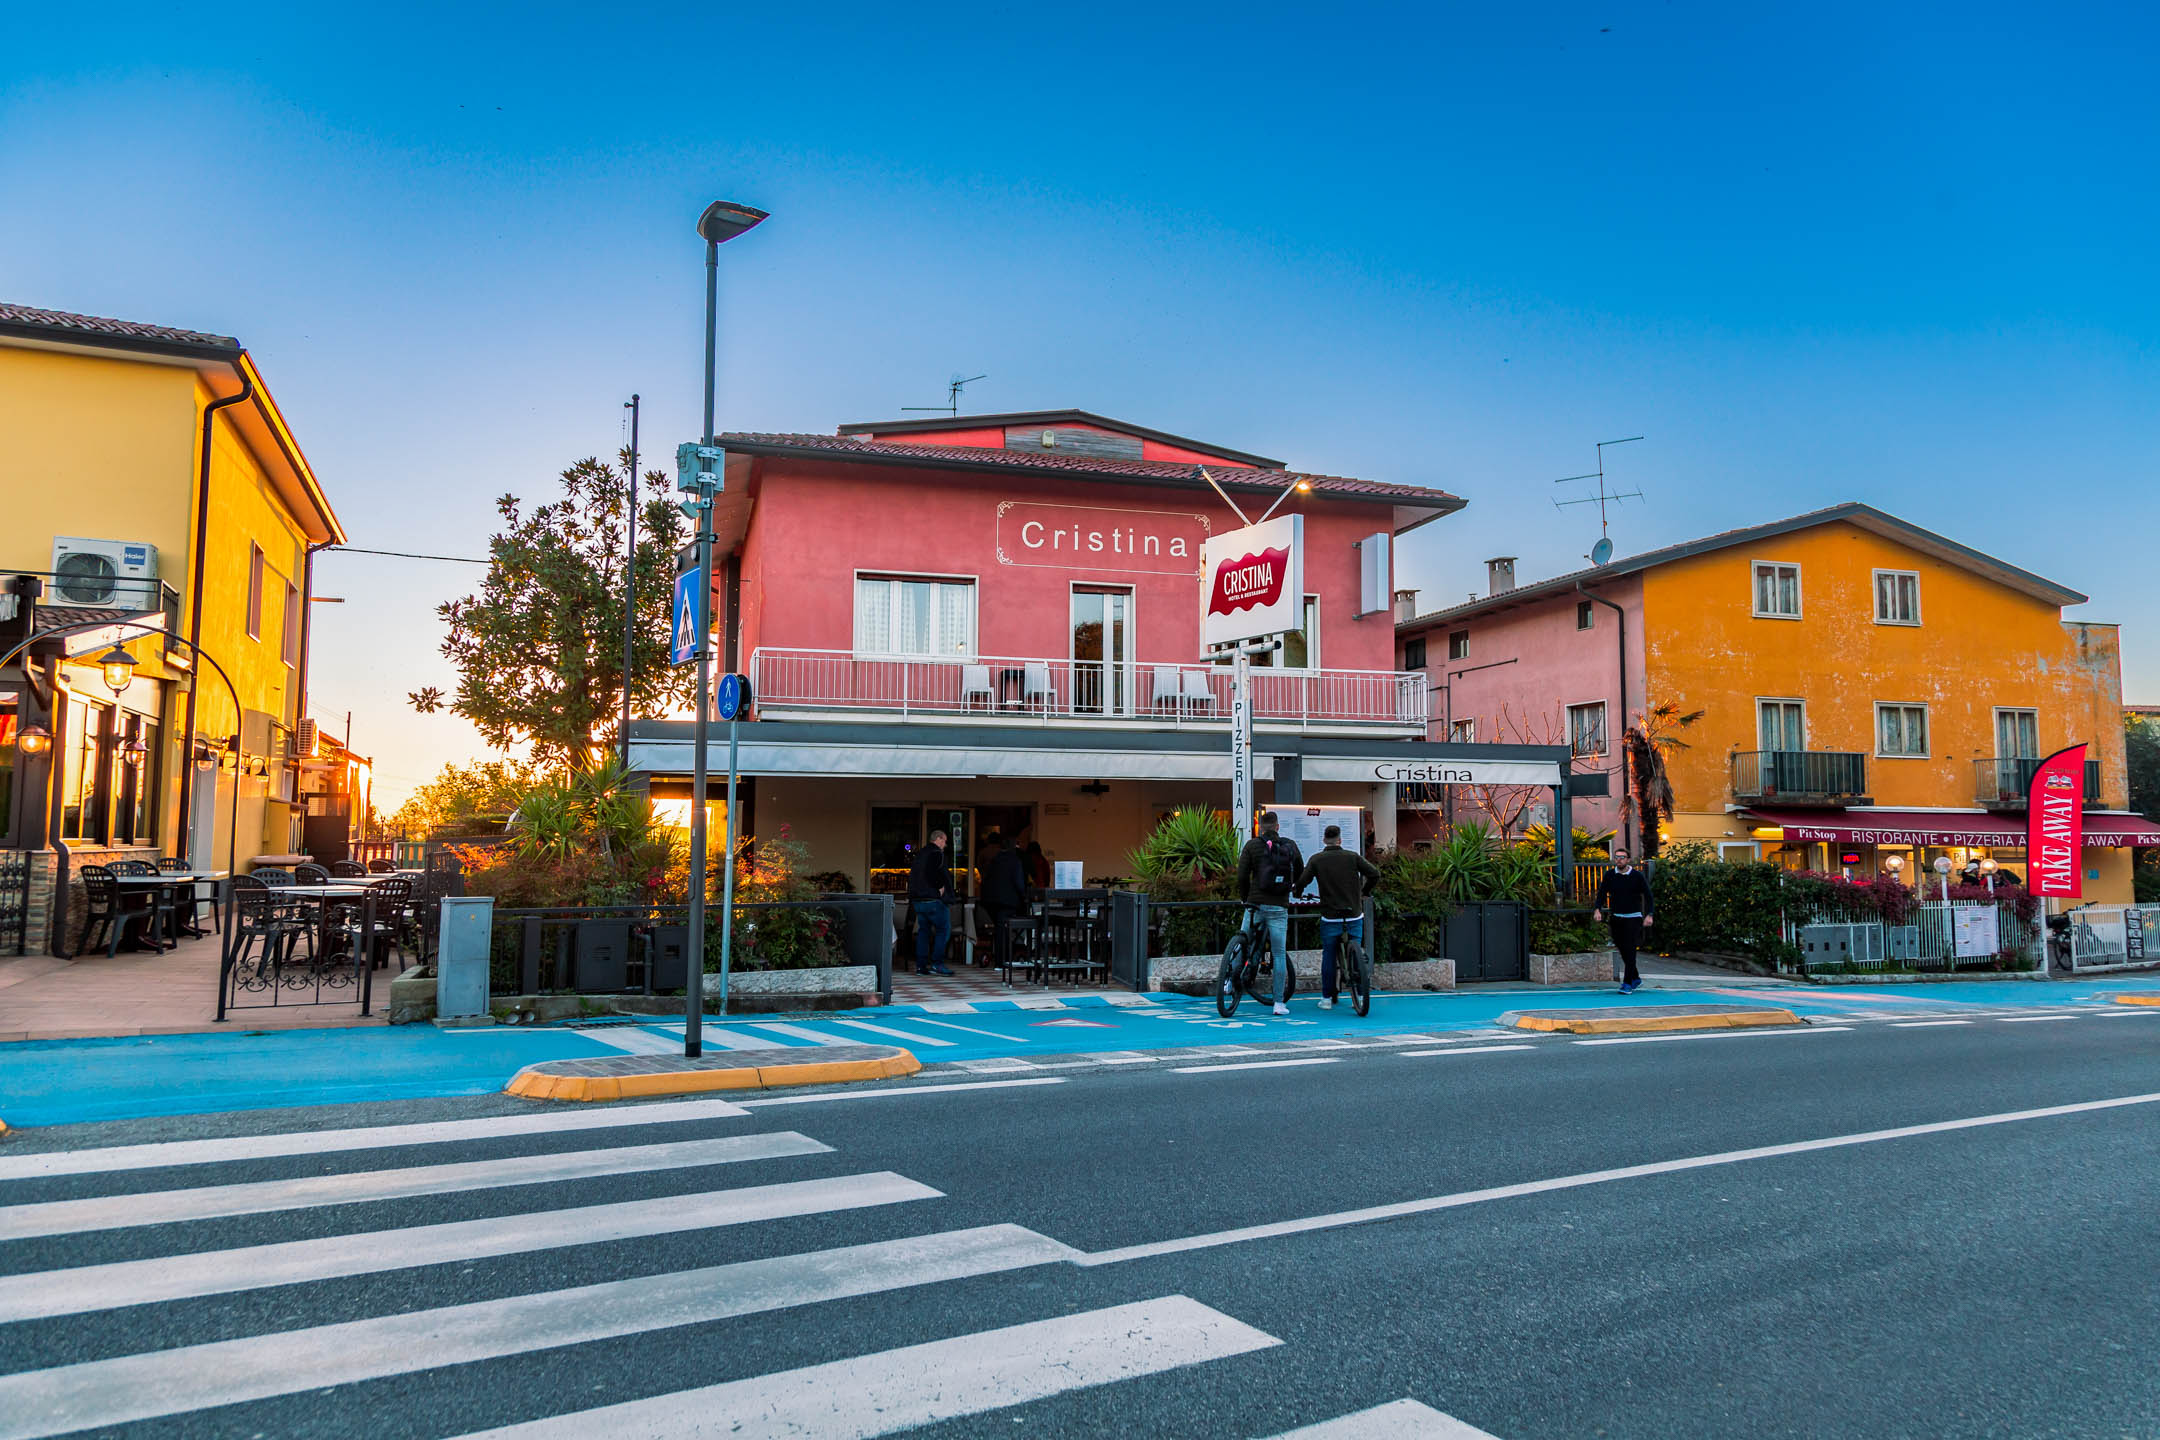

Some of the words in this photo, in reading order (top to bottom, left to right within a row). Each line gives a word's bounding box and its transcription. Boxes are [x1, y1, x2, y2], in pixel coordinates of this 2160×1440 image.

[1021, 521, 1187, 557] Cristina
[1223, 562, 1273, 595] CRISTINA
[1235, 702, 1244, 809] PIZZERIA
[1375, 763, 1473, 782] Cristina
[1799, 828, 1813, 839] Pit
[1814, 830, 1837, 842] Stop
[2043, 793, 2073, 844] AWAY
[1851, 831, 1938, 845] RISTORANTE
[1953, 834, 2015, 847] PIZZERIA
[2087, 835, 2123, 847] AWAY
[2137, 835, 2150, 844] Pit
[2042, 845, 2072, 892] TAKE
